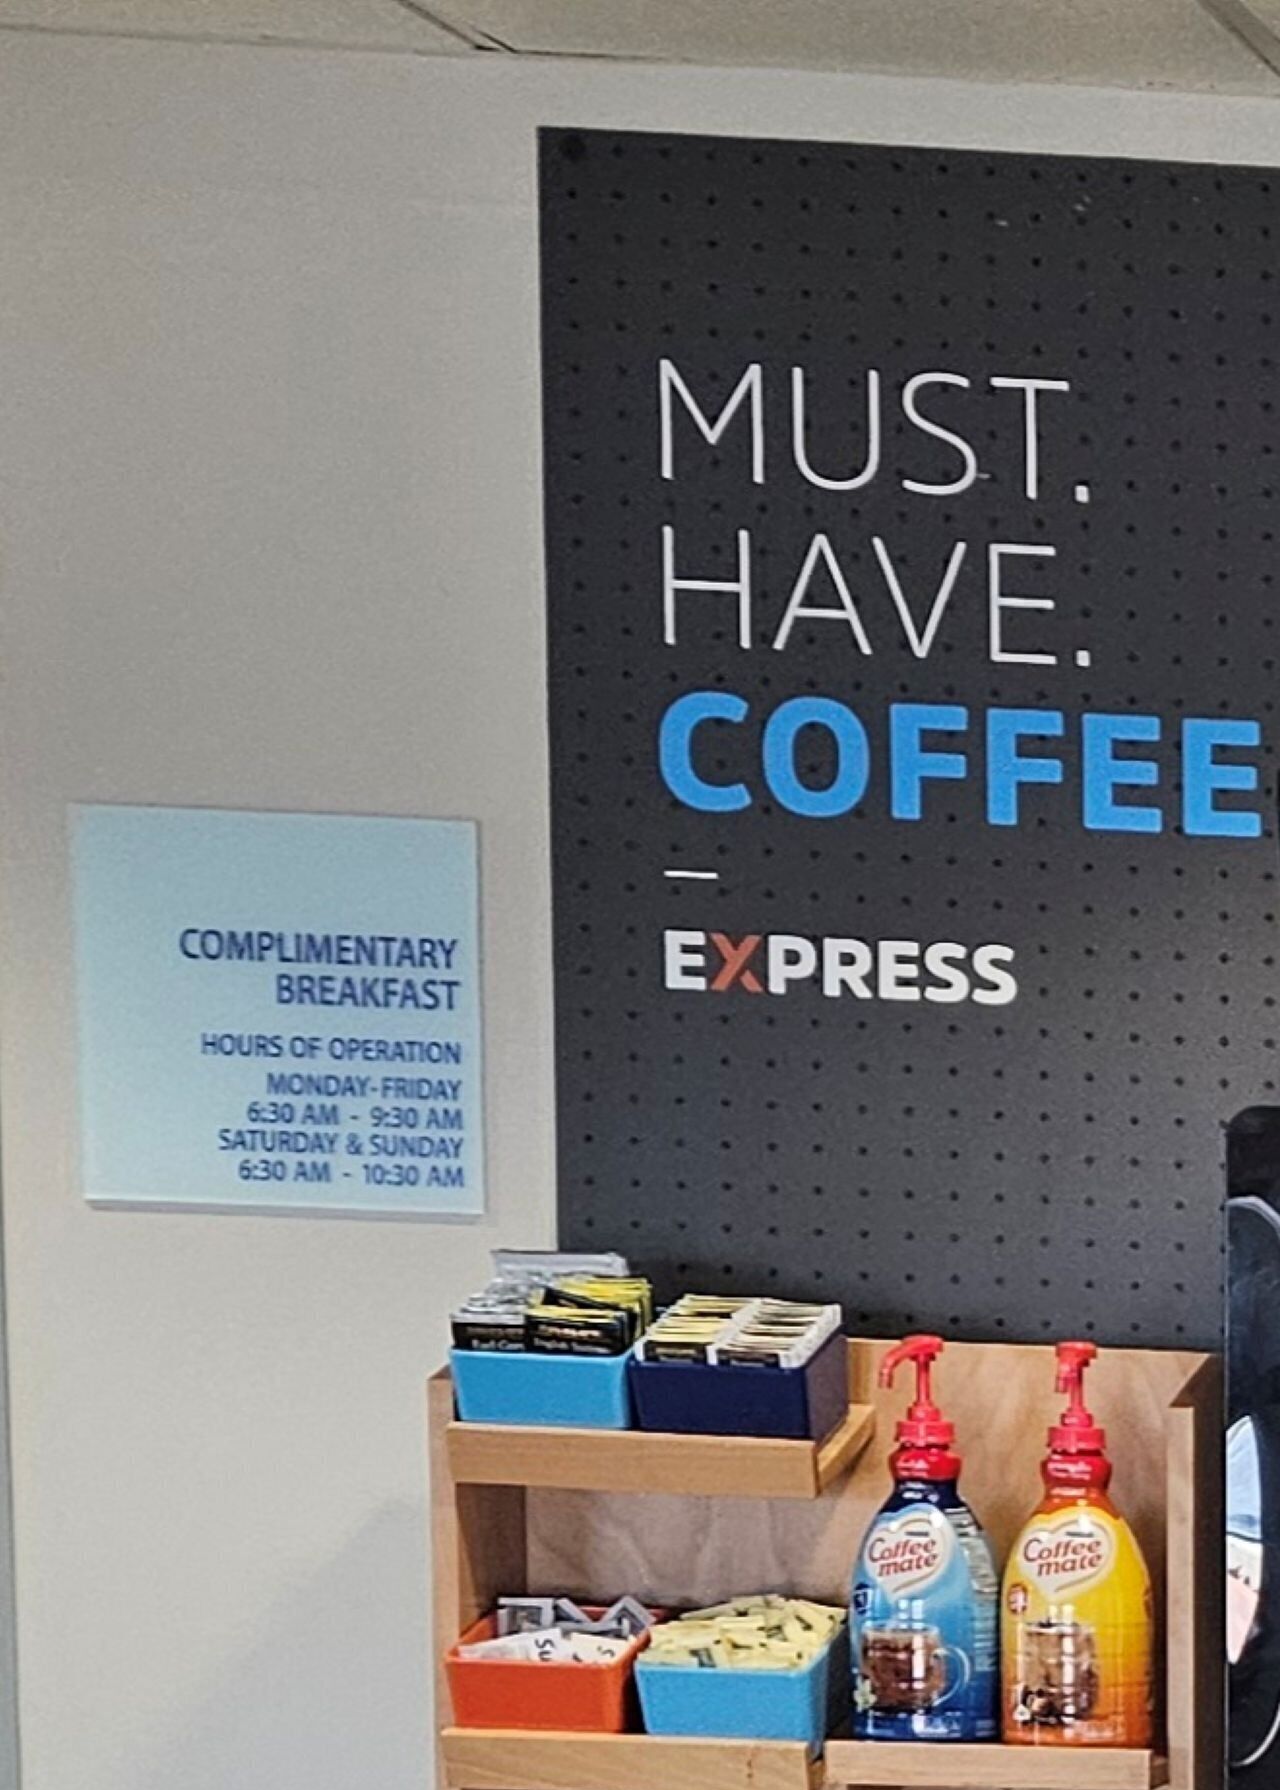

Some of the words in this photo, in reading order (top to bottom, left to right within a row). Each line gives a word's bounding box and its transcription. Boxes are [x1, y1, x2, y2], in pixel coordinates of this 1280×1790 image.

[660, 358, 1090, 503] MUST.
[661, 525, 1091, 667] HAVE.
[659, 690, 1262, 838] COFFEE
[179, 928, 459, 969] COMPLIMENTARY
[663, 929, 1018, 1006] EXPRESS
[276, 973, 461, 1010] BREAKFAST
[202, 1033, 283, 1058] HOURS
[290, 1036, 323, 1059] OF
[328, 1037, 461, 1064] OPERATION
[247, 1101, 294, 1124] 6:30
[302, 1103, 340, 1125] AM
[370, 1106, 419, 1129] 9:30
[426, 1107, 464, 1130] AM
[218, 1128, 339, 1153] SATURDAY
[346, 1133, 363, 1155] &
[369, 1134, 464, 1159] SUNDAY
[238, 1159, 287, 1182] 6:30
[293, 1161, 332, 1183] AM
[362, 1163, 420, 1187] 10:30
[427, 1165, 465, 1188] AM
[868, 1537, 936, 1563] Coffee
[877, 1553, 938, 1577] mate
[1023, 1537, 1101, 1562] Coffee
[1037, 1554, 1102, 1577] mate
